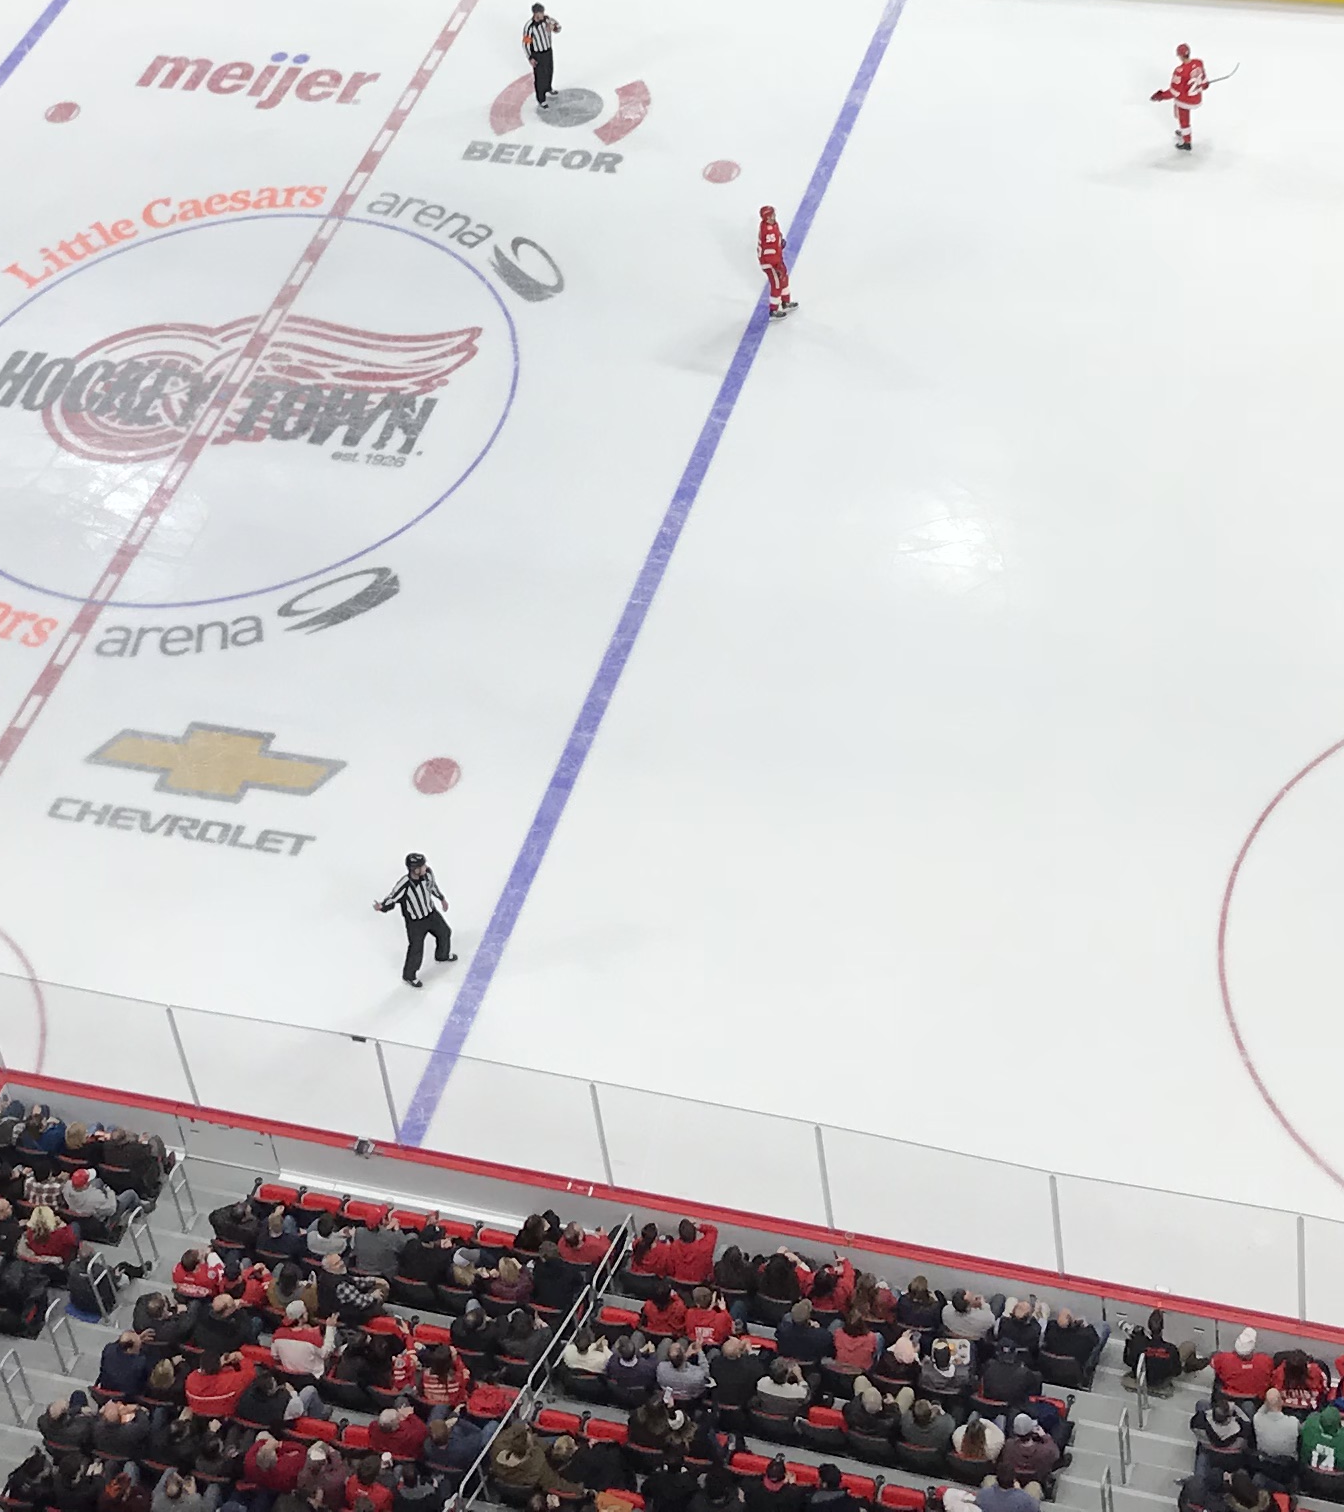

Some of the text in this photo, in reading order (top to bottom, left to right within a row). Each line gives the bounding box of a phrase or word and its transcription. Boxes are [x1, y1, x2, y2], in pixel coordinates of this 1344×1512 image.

[136, 51, 380, 110] meijer
[461, 139, 624, 175] BELFOR
[1, 183, 495, 289] Little Caesars arena
[95, 617, 266, 658] arena
[47, 796, 318, 858] CHEVROLET
